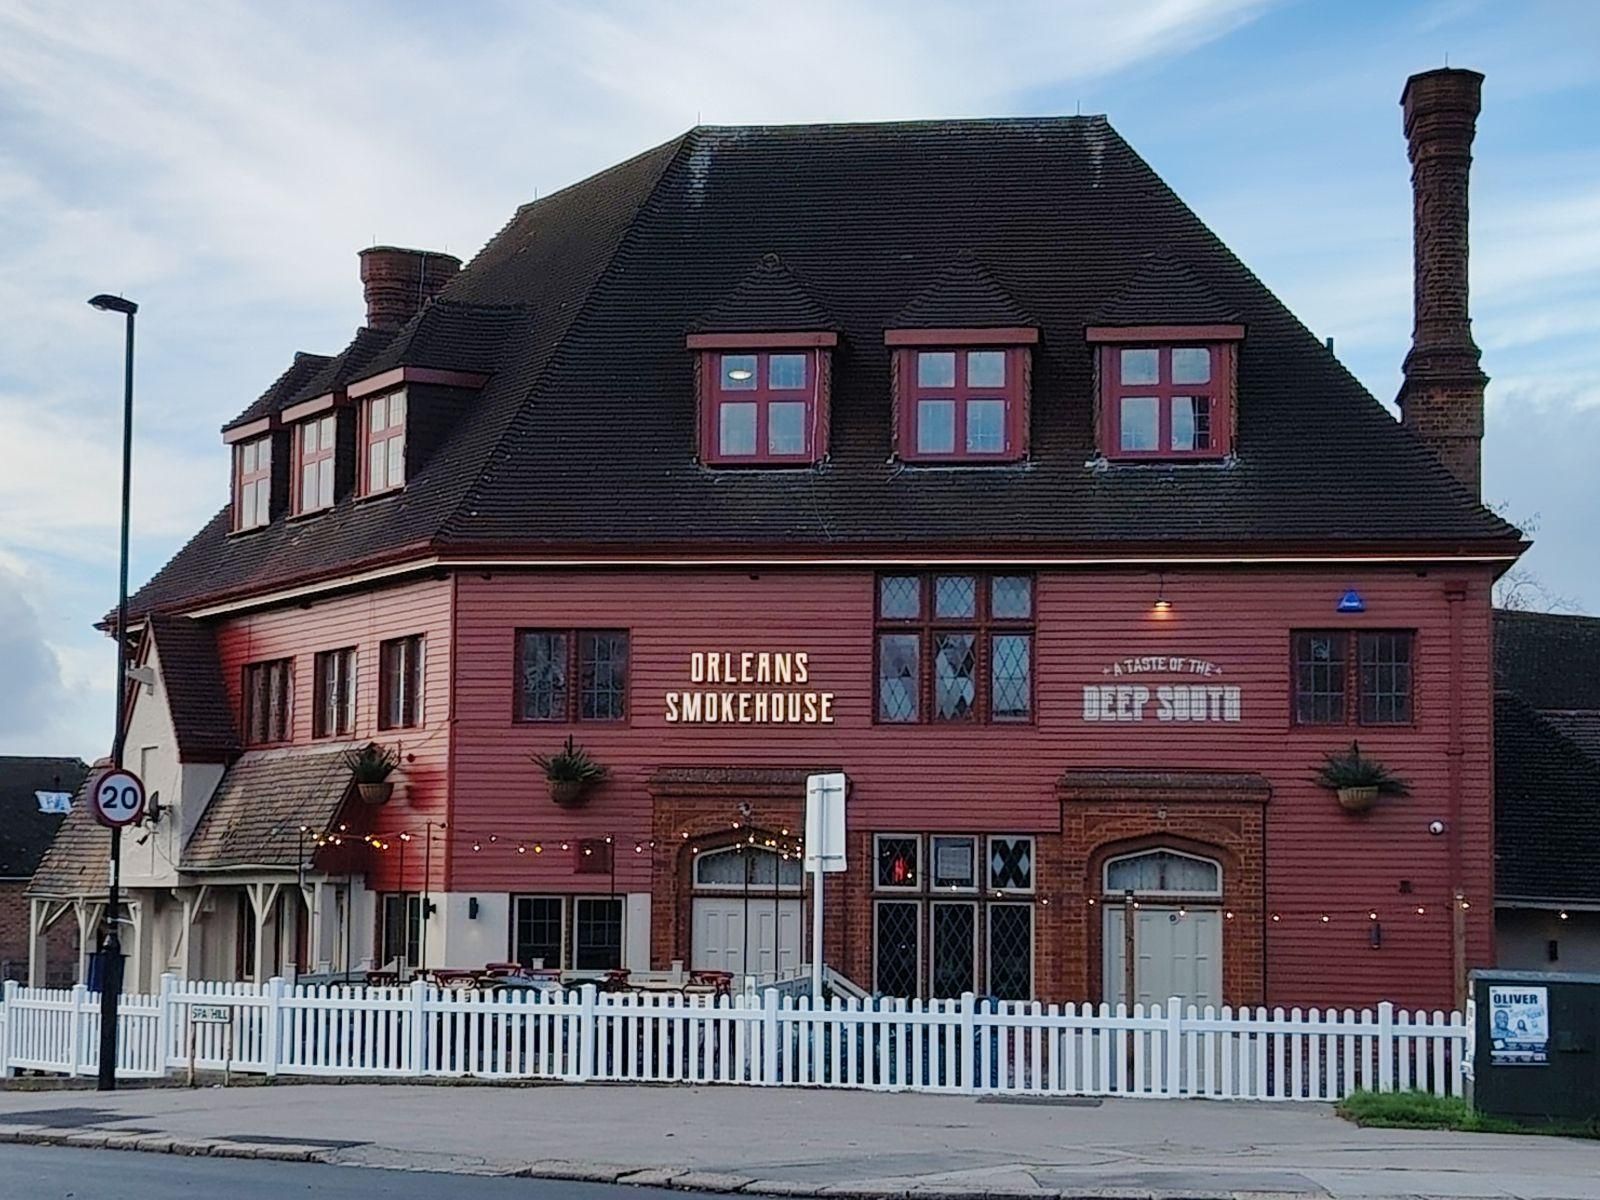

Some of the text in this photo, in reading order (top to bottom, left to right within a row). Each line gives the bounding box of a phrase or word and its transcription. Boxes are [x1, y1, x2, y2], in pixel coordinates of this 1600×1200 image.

[691, 652, 808, 683] ORLEANS
[1113, 656, 1215, 677] A TASTE OF THE
[665, 692, 834, 723] SMOKEHOUSE
[1083, 685, 1242, 722] DEEP SOUTH
[102, 785, 138, 810] 20
[1493, 993, 1538, 1005] OLIVER
